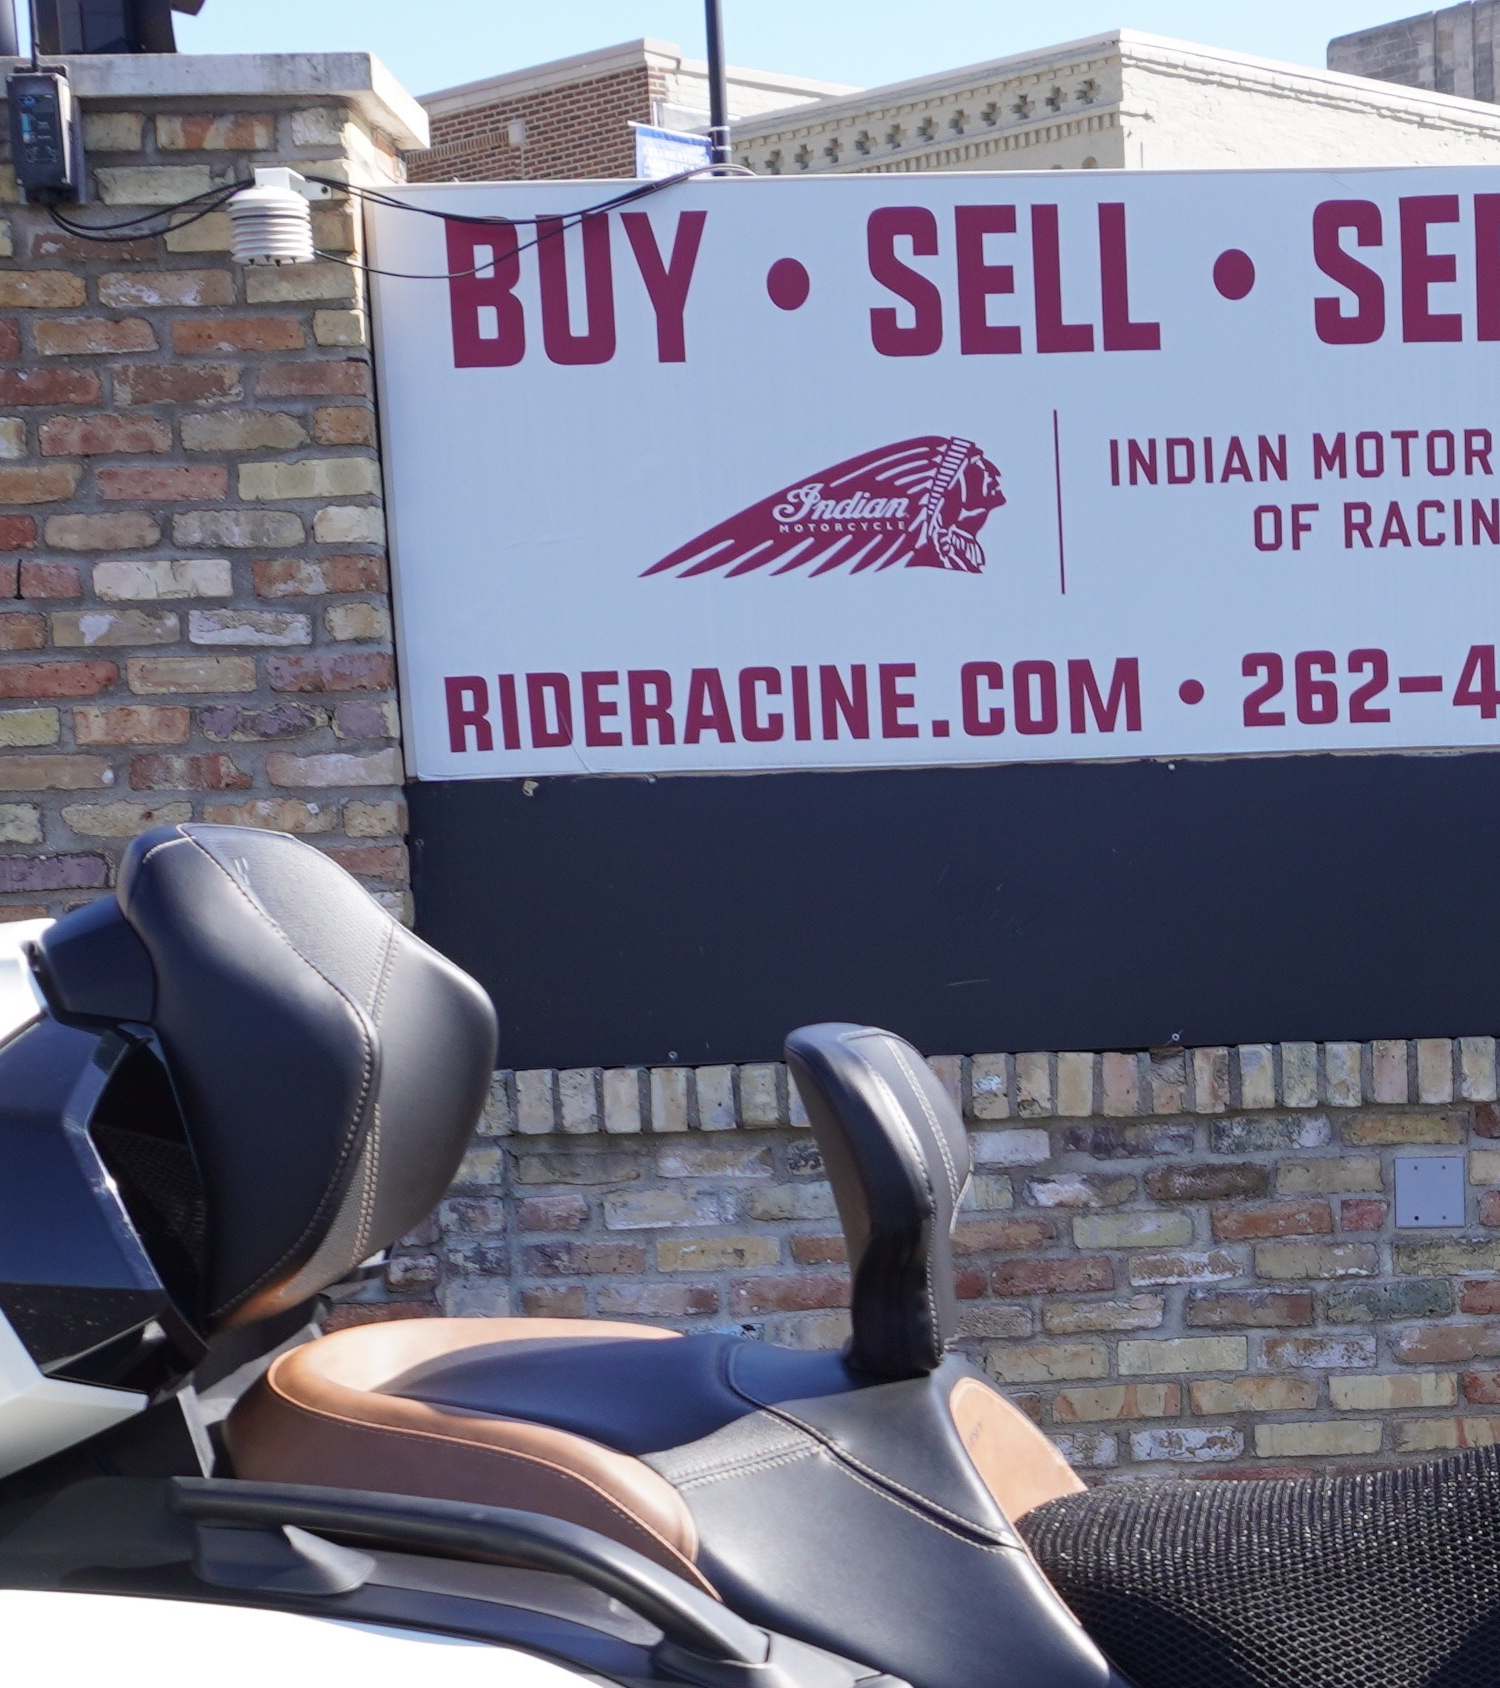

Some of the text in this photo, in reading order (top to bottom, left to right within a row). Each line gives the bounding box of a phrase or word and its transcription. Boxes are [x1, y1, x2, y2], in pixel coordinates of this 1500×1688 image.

[446, 212, 704, 368] BUY
[869, 204, 1160, 355] SELL
[1111, 437, 1286, 484] INDIAN
[772, 482, 910, 522] Indian
[779, 521, 910, 534] MOTORCYCLE
[1255, 505, 1317, 550] OF
[445, 659, 1141, 751] RIDERACINE.COM
